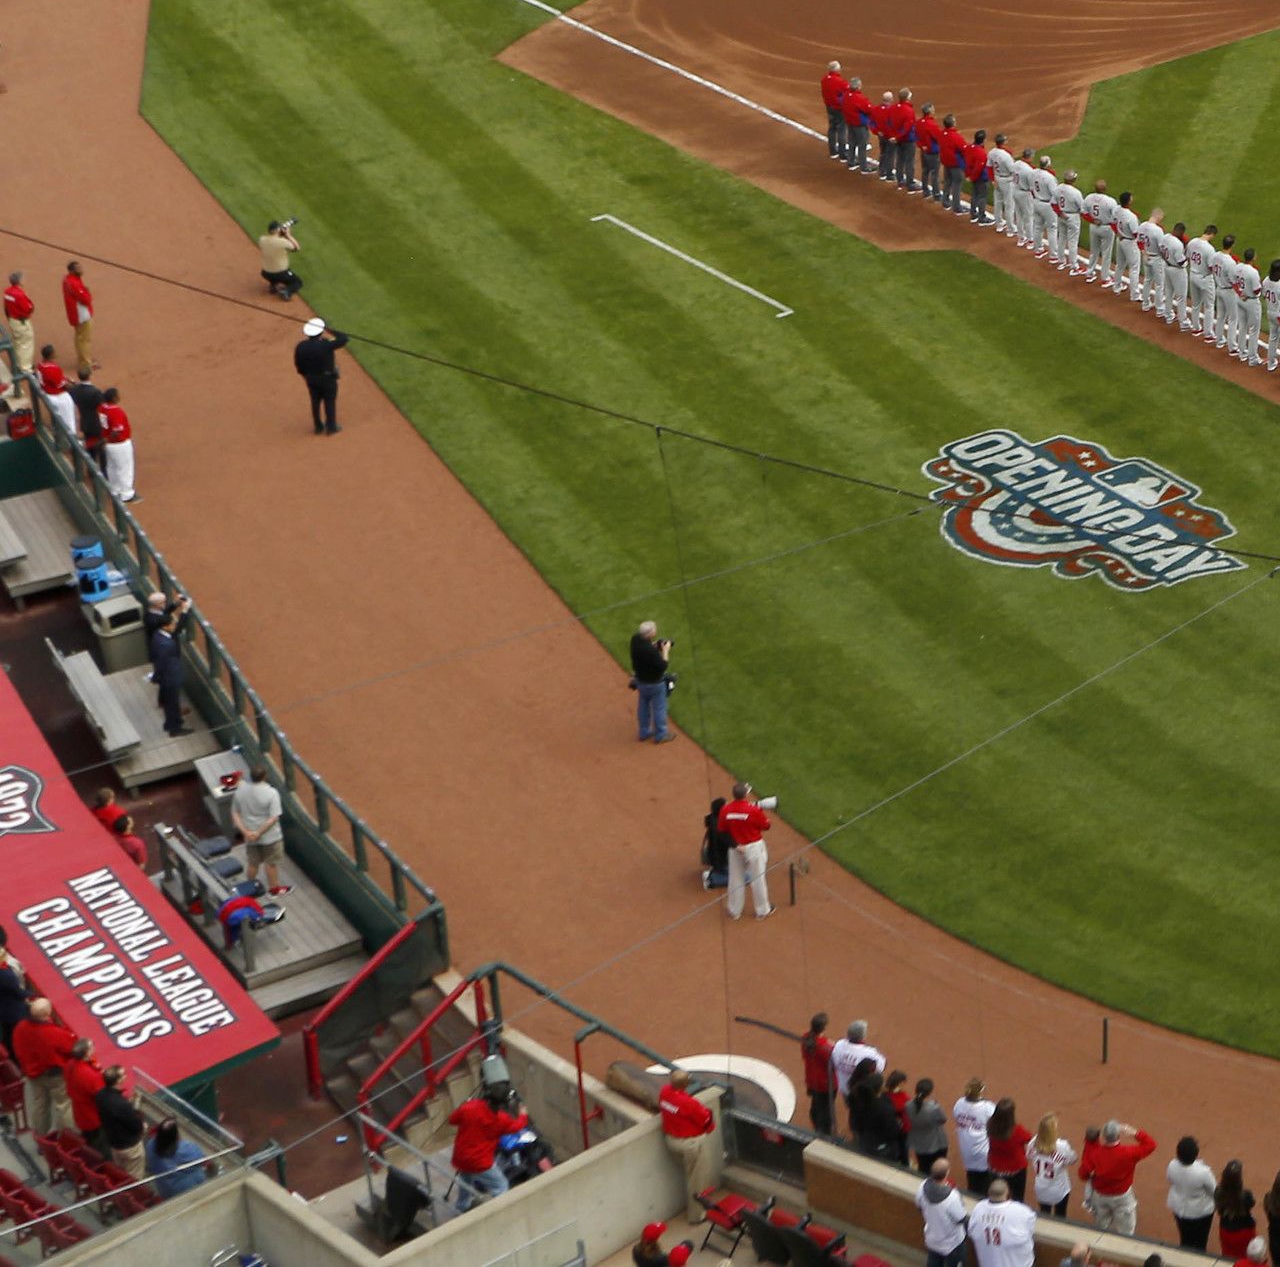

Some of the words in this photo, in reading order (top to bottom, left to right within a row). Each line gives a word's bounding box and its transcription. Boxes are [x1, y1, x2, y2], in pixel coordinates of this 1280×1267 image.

[1092, 204, 1100, 217] 5
[951, 433, 1146, 534] OPENING
[1108, 522, 1231, 580] DAY
[17, 896, 173, 1049] CHAMPIONS
[68, 868, 169, 962] NATIONAL
[141, 954, 236, 1037] LEAGUE
